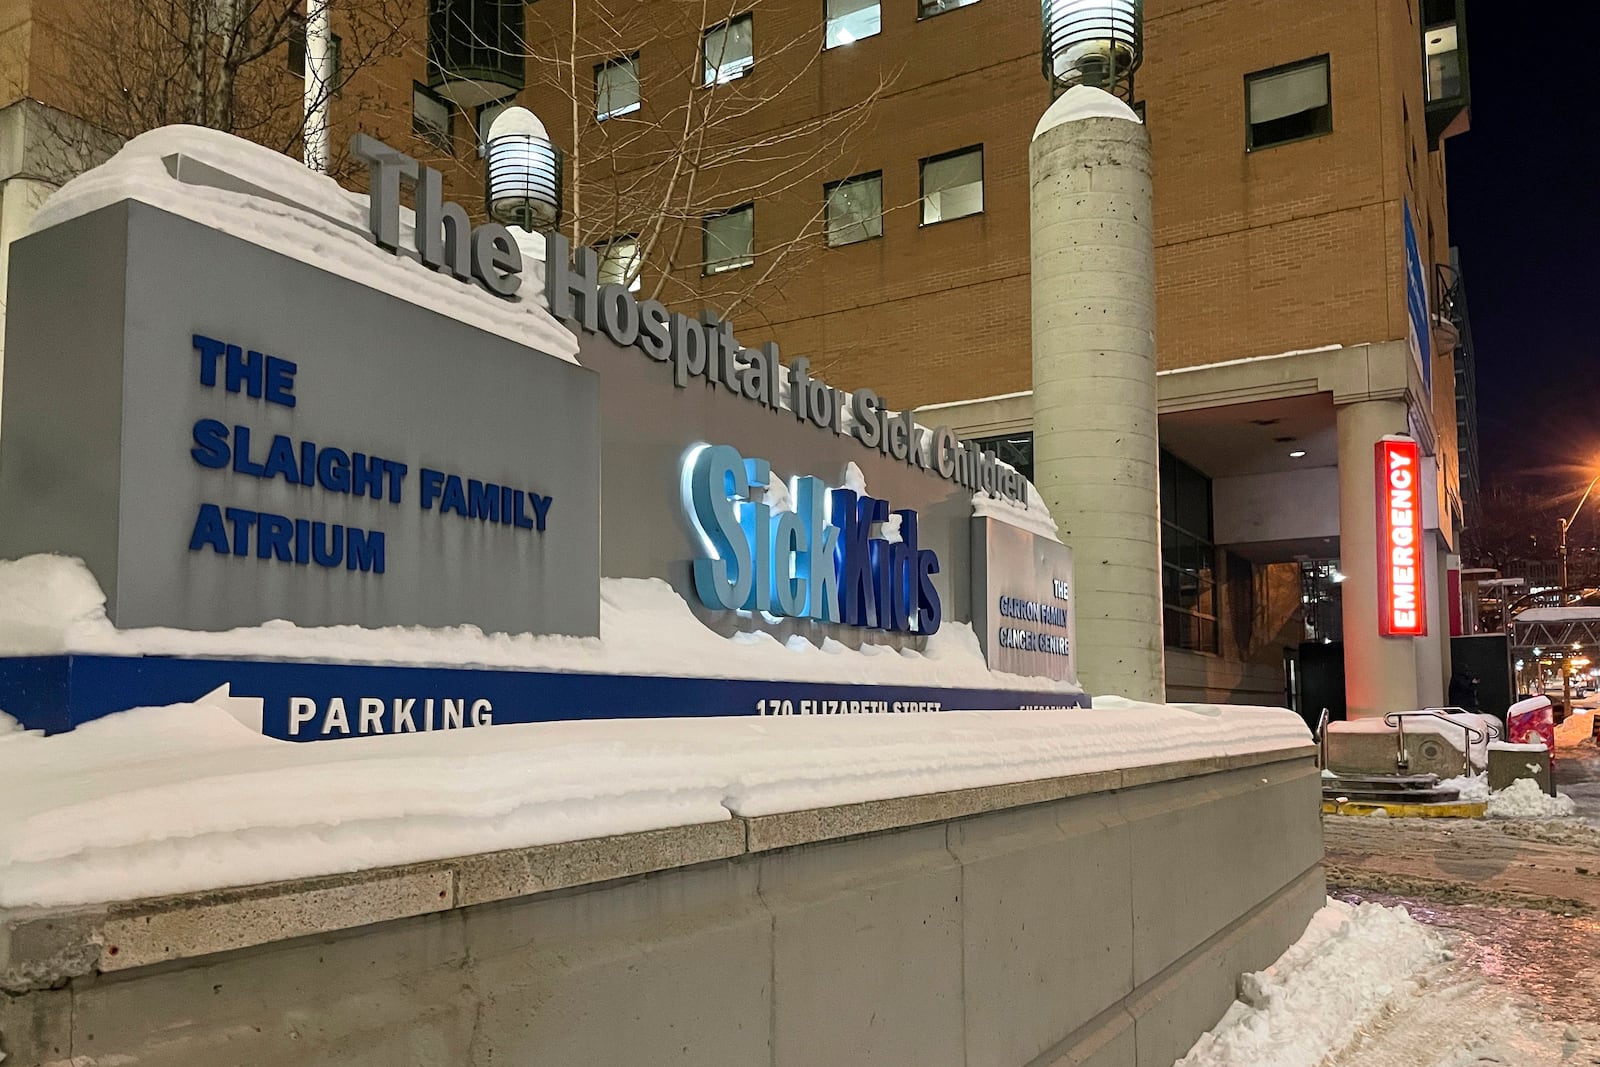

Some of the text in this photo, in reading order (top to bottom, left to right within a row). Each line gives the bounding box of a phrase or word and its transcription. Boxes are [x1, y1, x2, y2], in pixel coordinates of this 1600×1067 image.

[350, 133, 1028, 506] The Hospital for Sick Children
[192, 334, 296, 408] THE
[190, 419, 553, 531] SLAIGHT FAMILY
[189, 503, 386, 574] ATRIUM
[692, 444, 942, 635] SickKids
[1390, 451, 1417, 628] EMERGENCY
[1000, 595, 1068, 628] GARRON FAMILY
[1052, 578, 1069, 601] THE
[999, 626, 1069, 656] CANCER CENTRE
[287, 697, 494, 735] PARKING
[756, 699, 794, 716] 170
[800, 700, 889, 715] ELIZABETH
